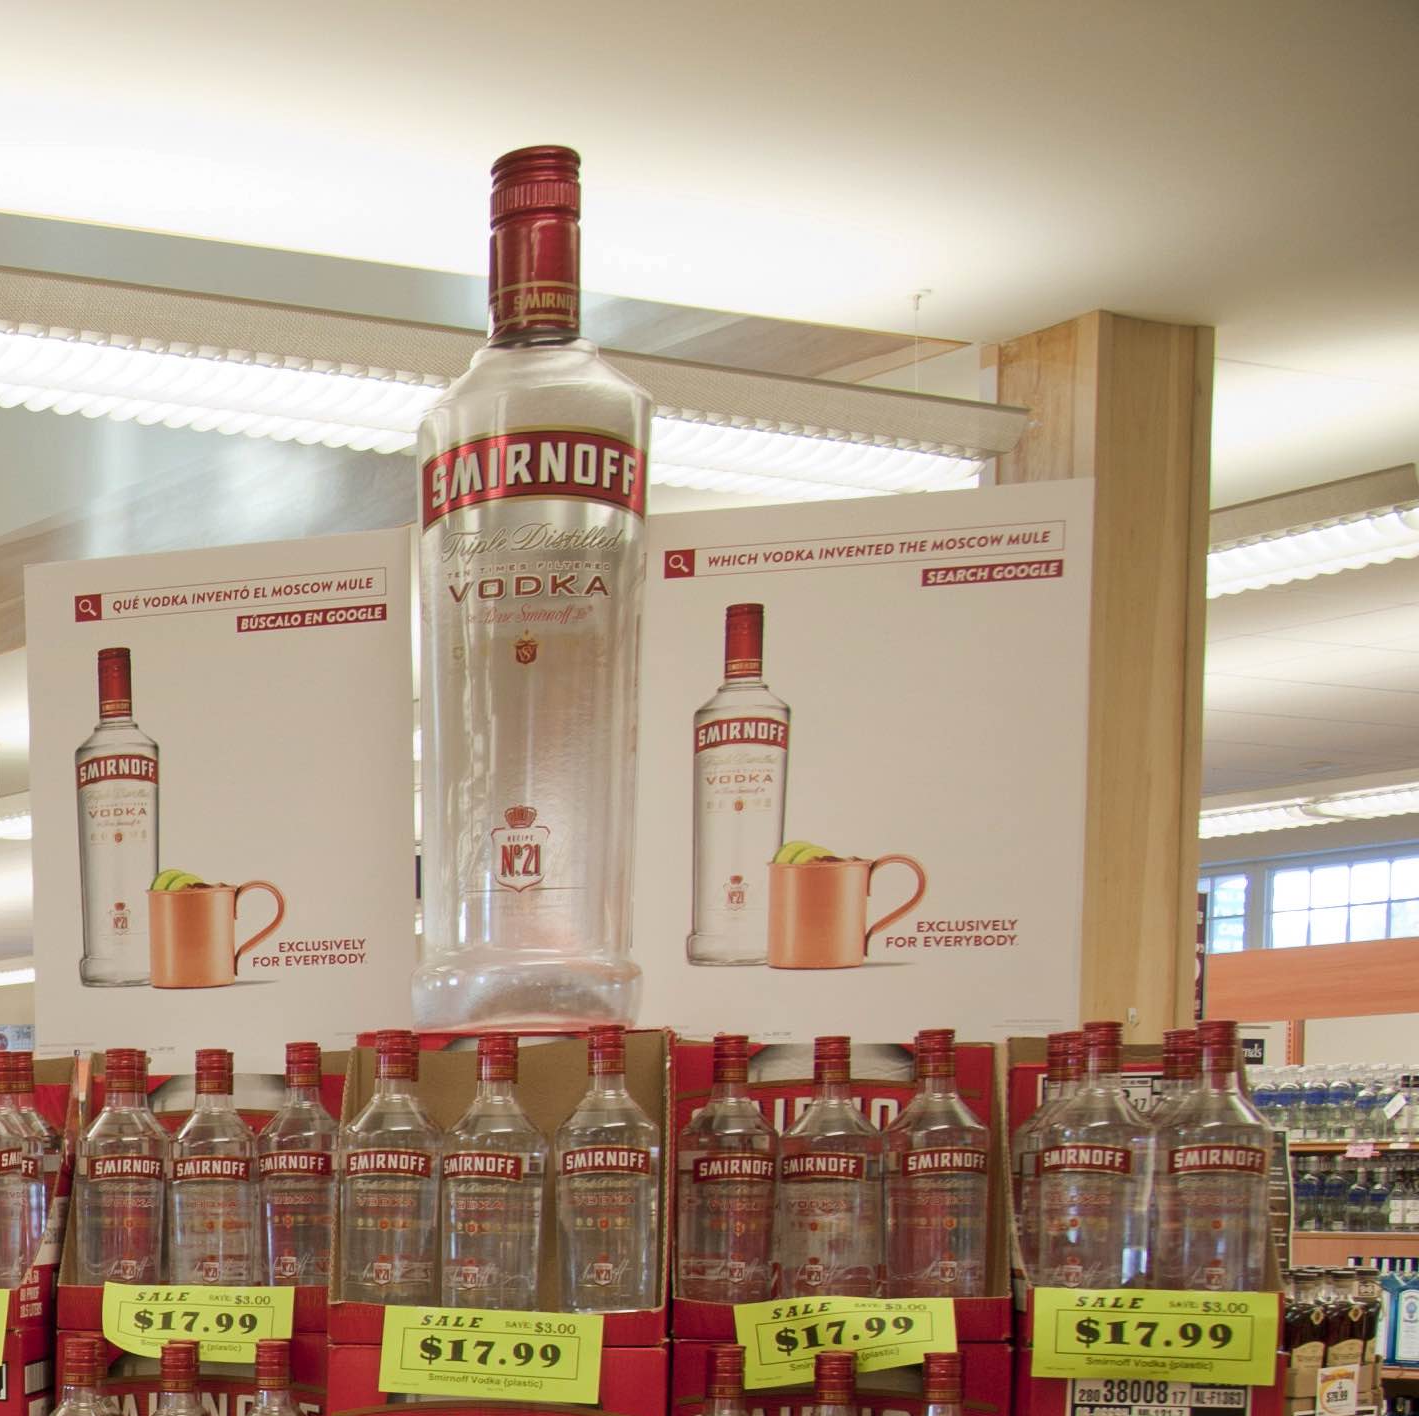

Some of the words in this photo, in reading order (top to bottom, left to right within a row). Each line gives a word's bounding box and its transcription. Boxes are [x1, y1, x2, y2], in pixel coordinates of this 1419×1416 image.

[431, 441, 637, 506] SMIRNOFF
[442, 532, 507, 562] Triple
[511, 521, 624, 553] Distilled
[707, 551, 758, 567] WHICH
[762, 547, 814, 564] VODKA
[818, 543, 895, 561] INVENTED
[899, 539, 927, 555] THE
[931, 533, 1003, 551] MOSCOW
[1007, 530, 1051, 546] MULE
[536, 561, 612, 572] FILTERED
[926, 567, 988, 585] SEARCH
[992, 562, 1059, 580] GOOGLE
[112, 596, 140, 613] QUÉ
[142, 593, 189, 610] VODKA
[191, 585, 250, 606] INVENTÓ
[254, 585, 268, 599] EL
[271, 580, 333, 598] MOSCOW
[336, 576, 374, 592] MULE
[448, 574, 612, 603] VODKA
[240, 611, 301, 631] BÚSCALO
[304, 611, 323, 625] EN
[326, 606, 382, 623] GOOGLE
[916, 918, 1018, 933] EXCLUSIVELY
[278, 938, 366, 953] EXCLUSIVELY
[885, 935, 918, 949] FOR
[252, 955, 280, 968] FOR
[420, 1315, 485, 1329] SALE
[534, 1322, 577, 1335] $3.00
[420, 1336, 563, 1369] $17.99
[1103, 1380, 1169, 1404] 38008
